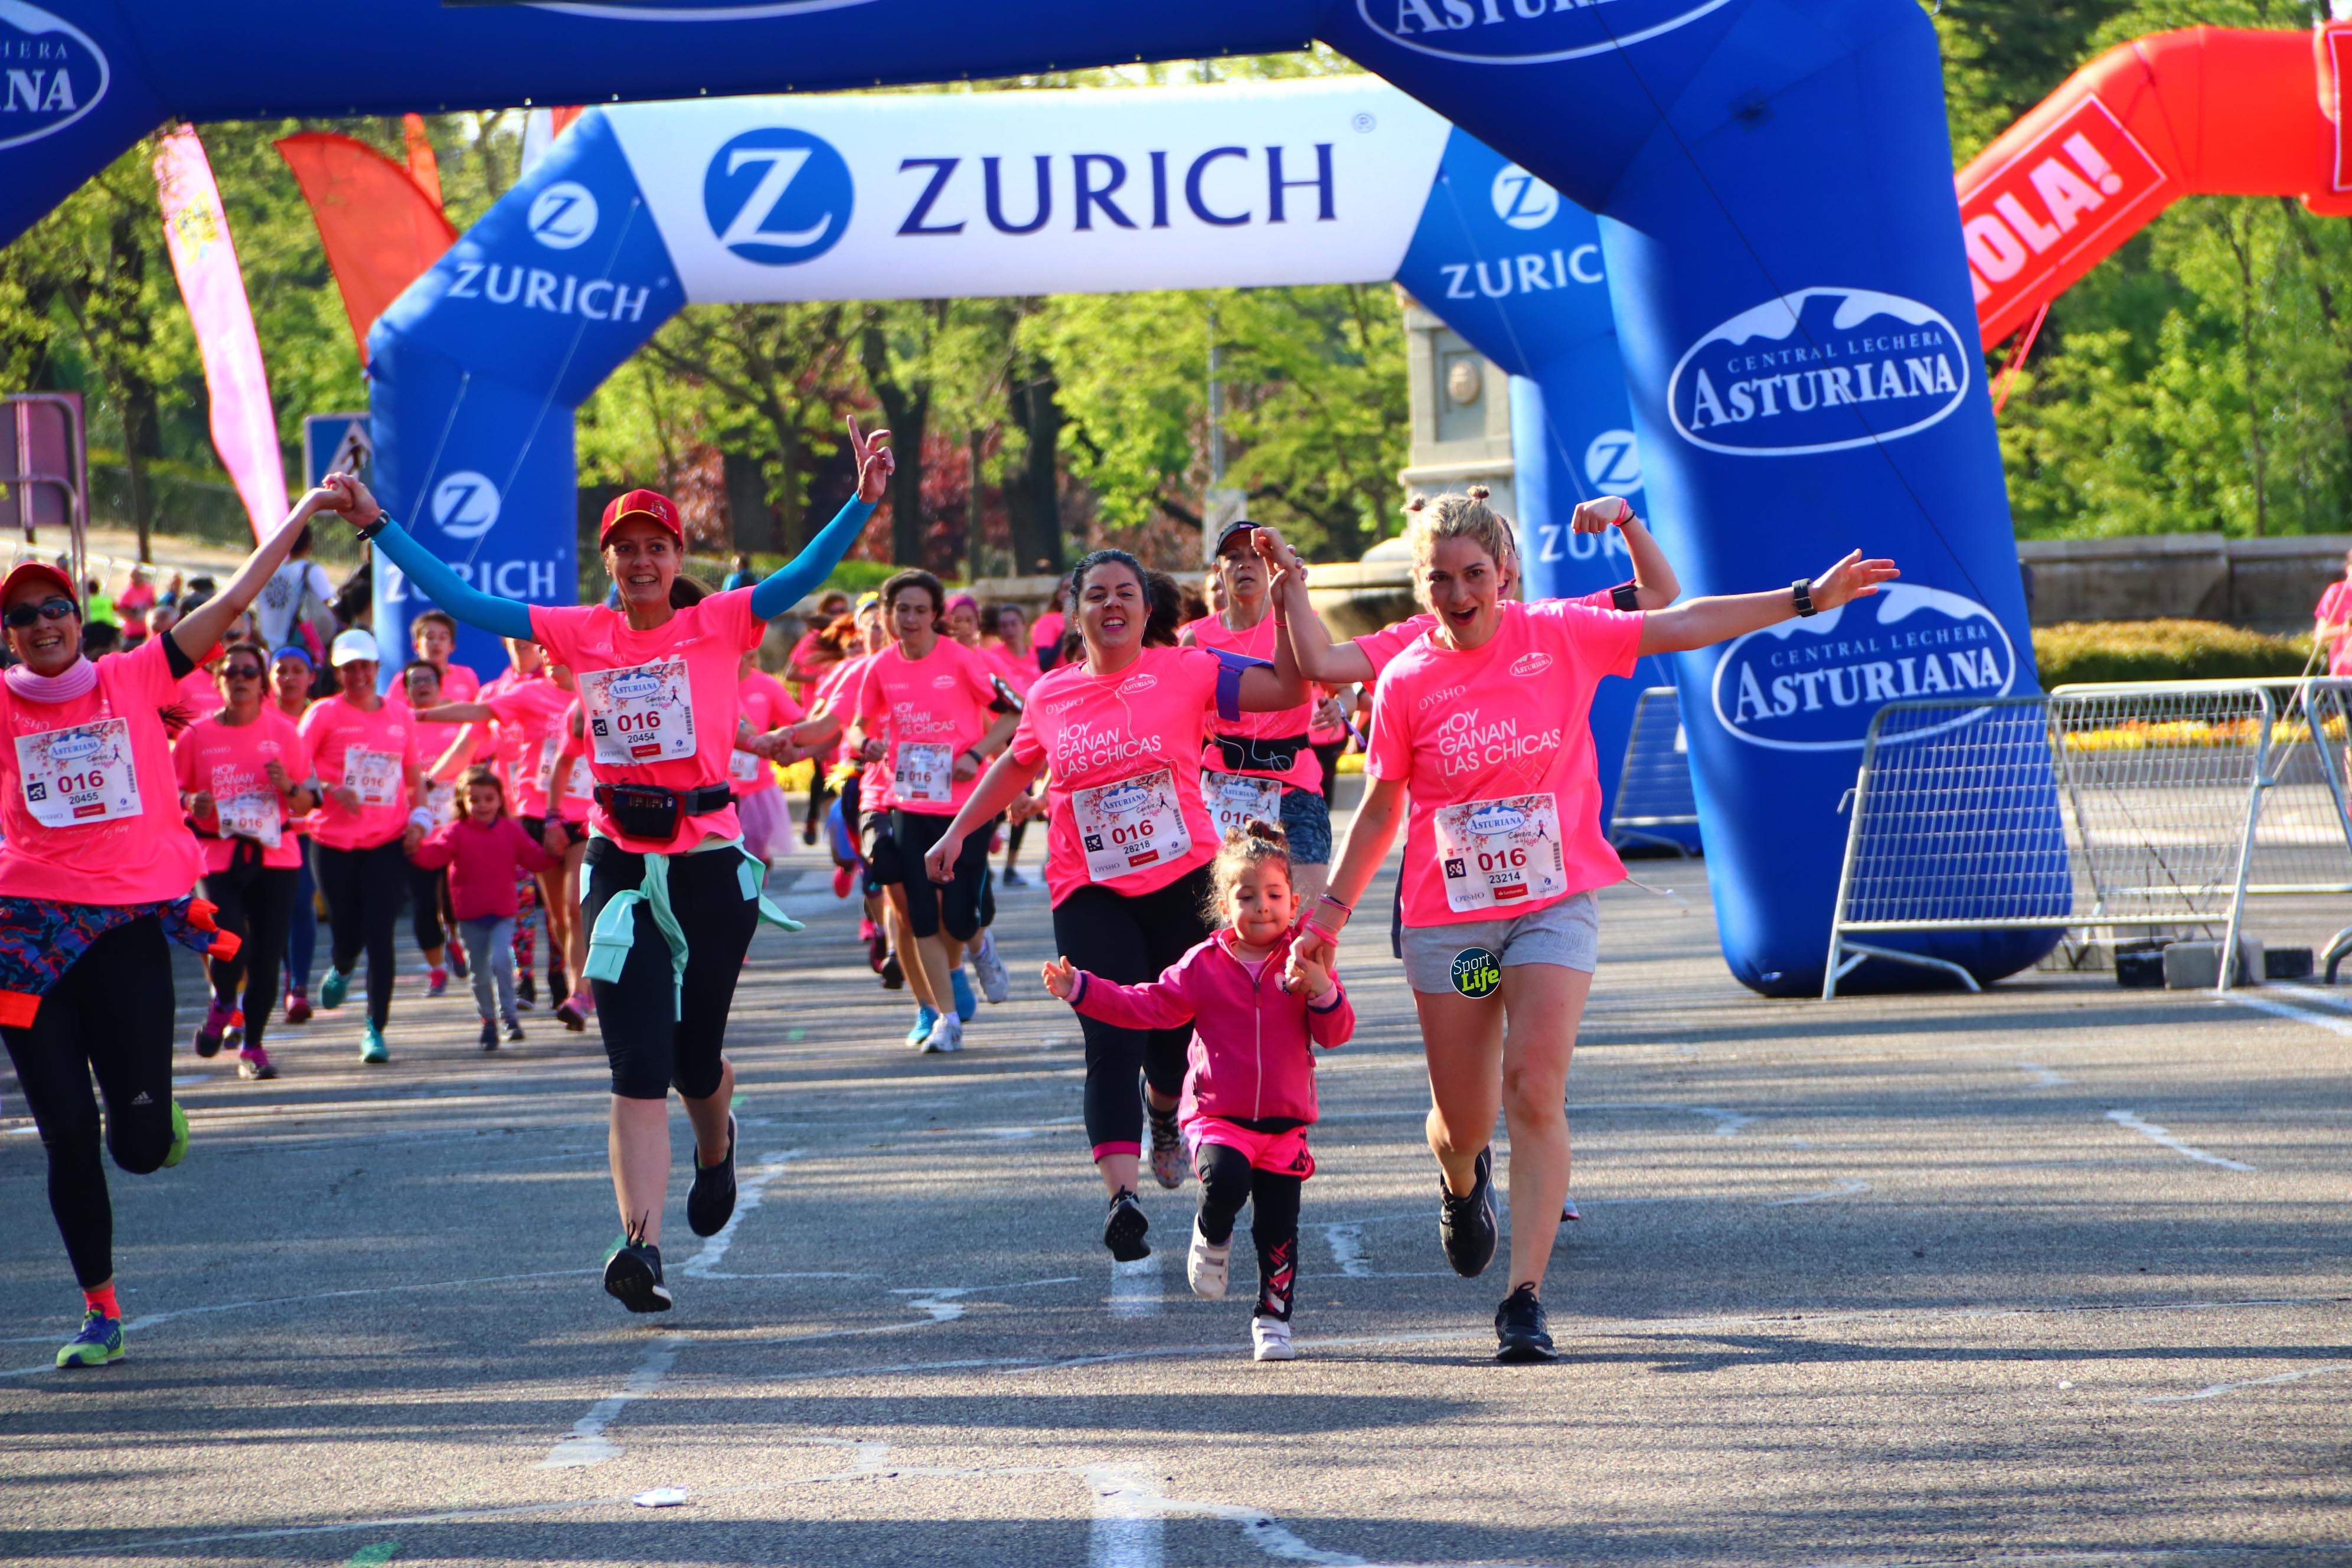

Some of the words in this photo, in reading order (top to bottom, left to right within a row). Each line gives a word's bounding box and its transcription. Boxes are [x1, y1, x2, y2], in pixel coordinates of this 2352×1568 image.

[896, 143, 1338, 236] ZURICH
[1962, 131, 2124, 305] OLA!
[447, 262, 651, 322] ZURICH
[1727, 343, 1837, 374] CENTRAL
[1848, 331, 1943, 355] LECHERA
[1690, 353, 1958, 431] ASTURIANA
[1771, 638, 1881, 668] CENTRAL
[1892, 624, 1989, 649] LECHERA
[612, 682, 658, 695] ASTURIANA
[1734, 647, 2003, 724] ASTURIANA
[1046, 698, 1084, 715] OYSHO
[1419, 685, 1466, 710] OYSHO
[894, 702, 914, 713] HOY
[618, 711, 661, 732] 016
[915, 720, 955, 734] CHICAS
[1438, 708, 1478, 738] HOY
[628, 733, 655, 743] 20454
[1058, 721, 1092, 744] HOY
[1439, 718, 1517, 756] GANAN
[51, 741, 99, 757] ASTURIANA
[1057, 727, 1119, 760] GANAN
[1445, 752, 1479, 776] LAS
[1485, 729, 1561, 765] CHICAS
[1060, 756, 1089, 778] LAS
[1092, 735, 1162, 766] CHICAS
[213, 764, 237, 775] HOY
[909, 771, 932, 782] 016
[58, 770, 105, 793] 016
[213, 773, 255, 786] GANAN
[361, 776, 384, 787] 016
[69, 792, 99, 805] 20455
[213, 786, 233, 798] LAS
[1103, 792, 1146, 810] ASTURIANA
[239, 818, 263, 831] 016
[1112, 819, 1154, 844] 016
[1471, 817, 1521, 831] ASTURIANA
[1123, 840, 1151, 855] 28218
[1095, 863, 1121, 873] OYSHO
[1478, 848, 1527, 871] 016
[1489, 871, 1521, 884] 23214
